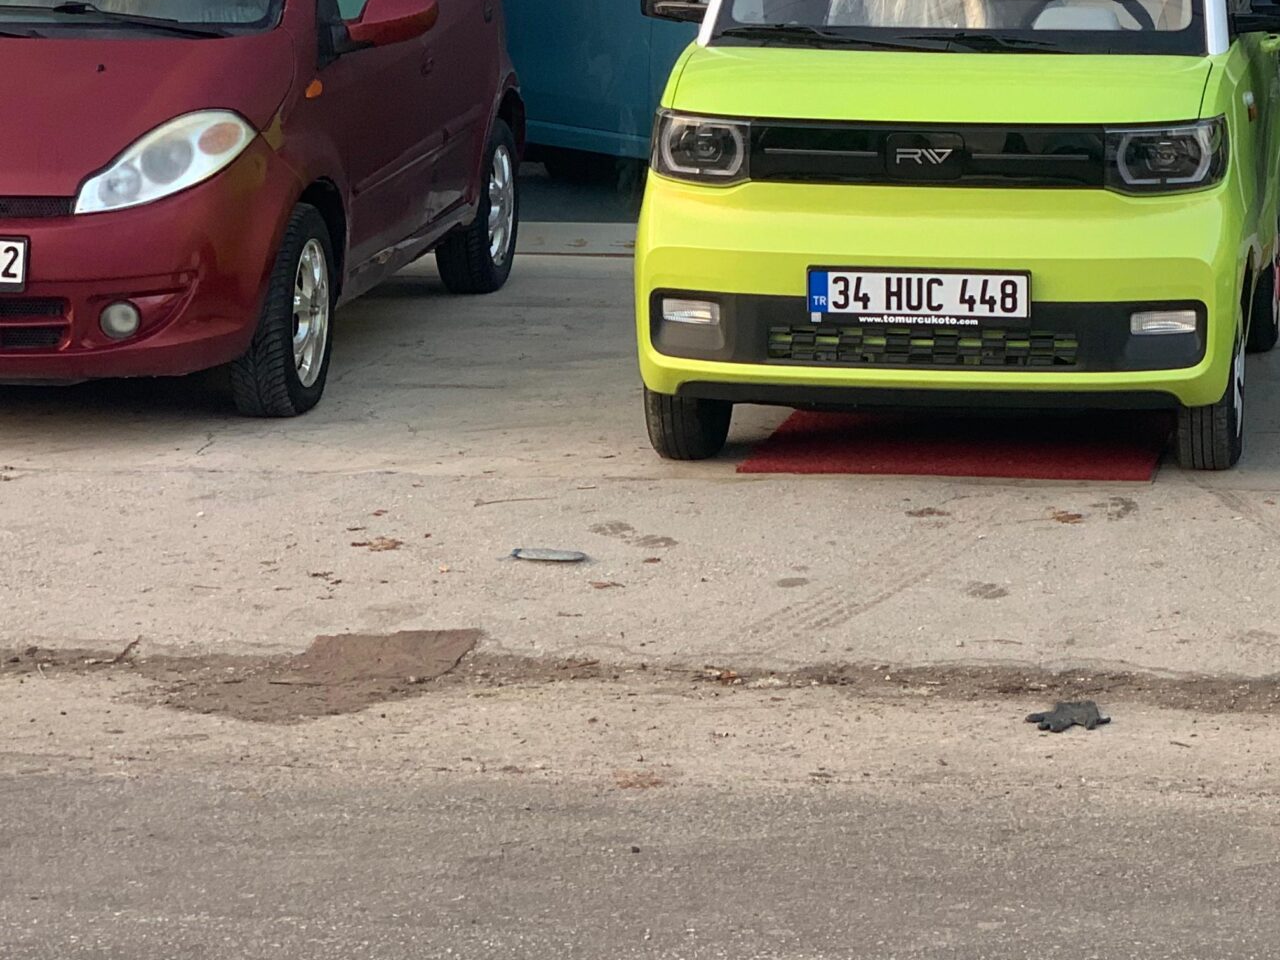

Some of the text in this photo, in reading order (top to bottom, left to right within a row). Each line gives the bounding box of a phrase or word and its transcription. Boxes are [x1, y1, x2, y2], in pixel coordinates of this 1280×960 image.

[832, 276, 1018, 313] 34 HUC 448
[813, 296, 827, 306] TR
[858, 314, 979, 326] www.tomurcukoto.com
